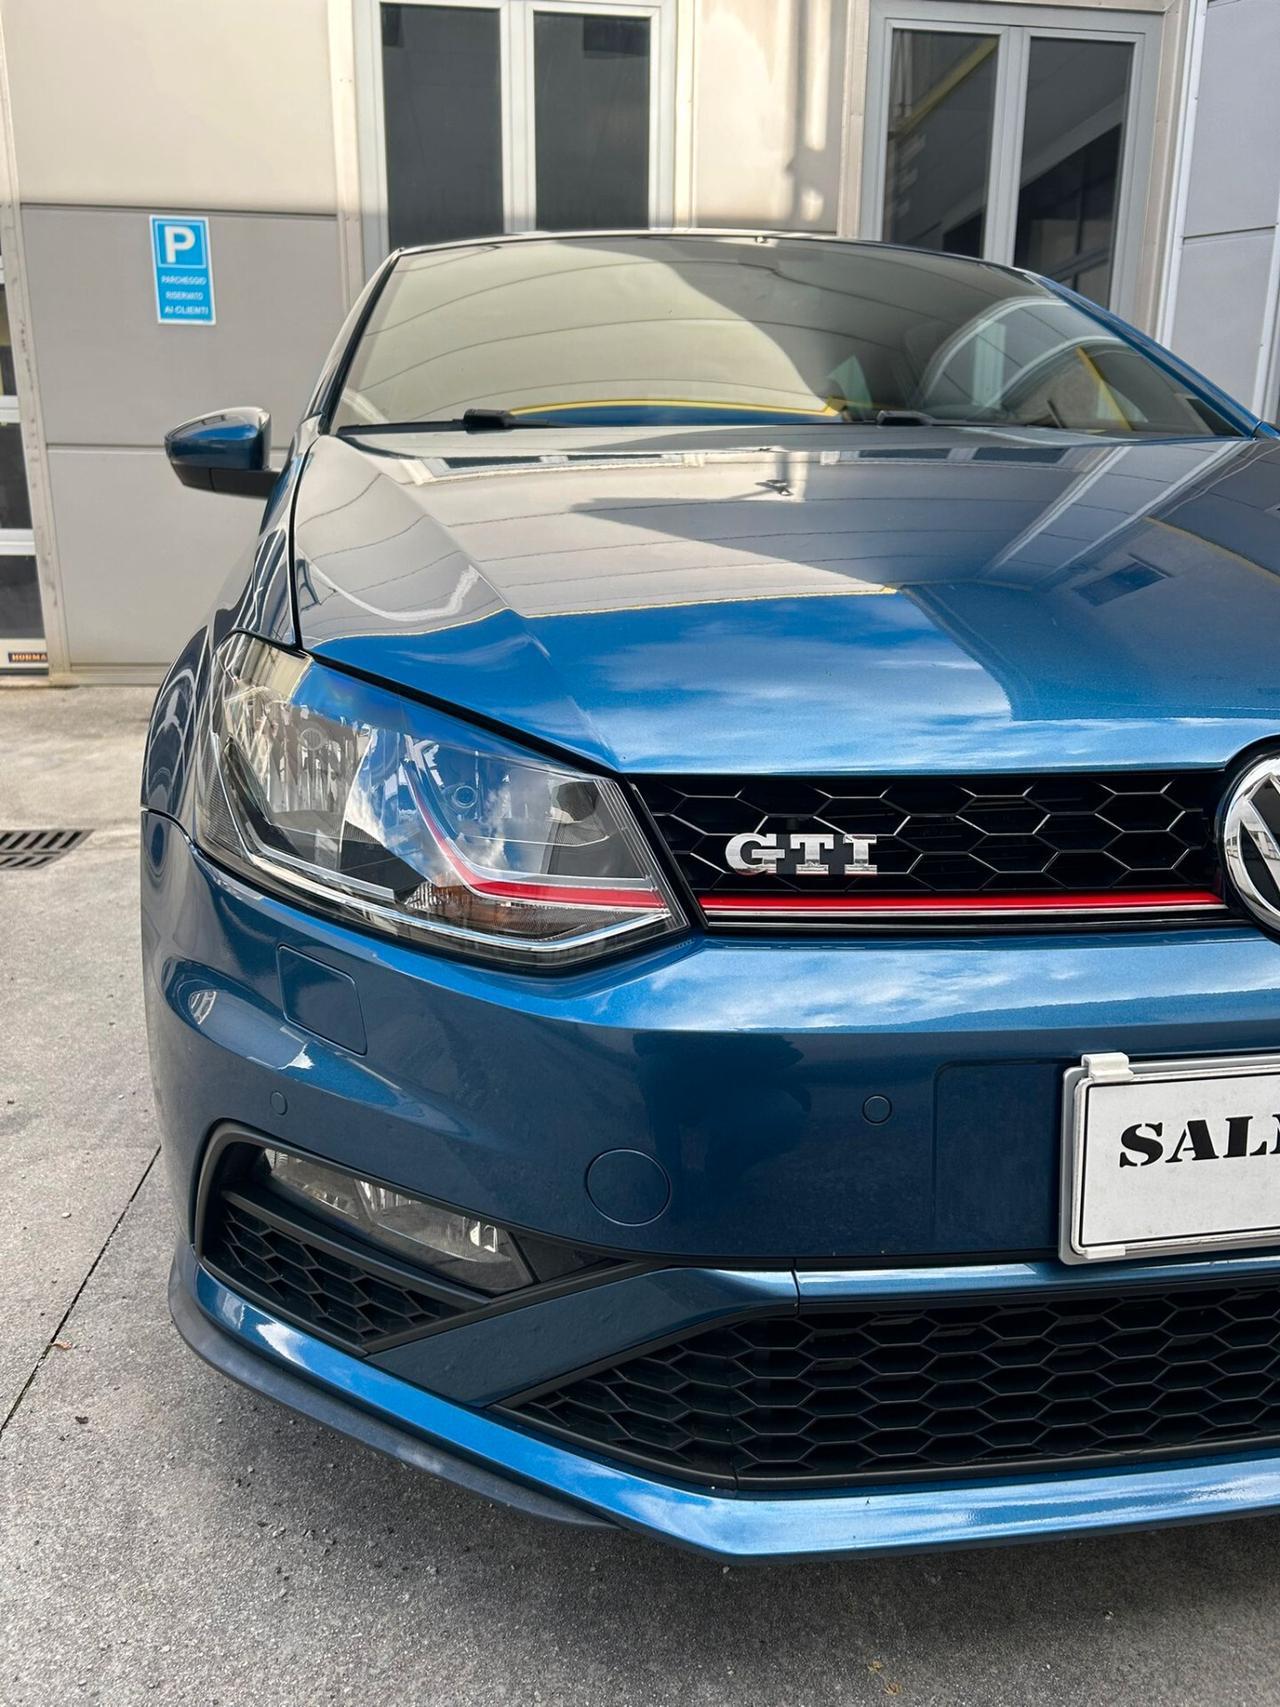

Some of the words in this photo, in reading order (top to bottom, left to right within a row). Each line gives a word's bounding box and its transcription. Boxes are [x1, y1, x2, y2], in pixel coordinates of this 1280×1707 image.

[164, 226, 195, 263] P
[161, 276, 207, 285] PARCHEGGIO
[166, 291, 204, 300] RISERVATO
[165, 306, 173, 314] AI
[175, 306, 208, 314] CLIENTI
[725, 833, 877, 875] GTI
